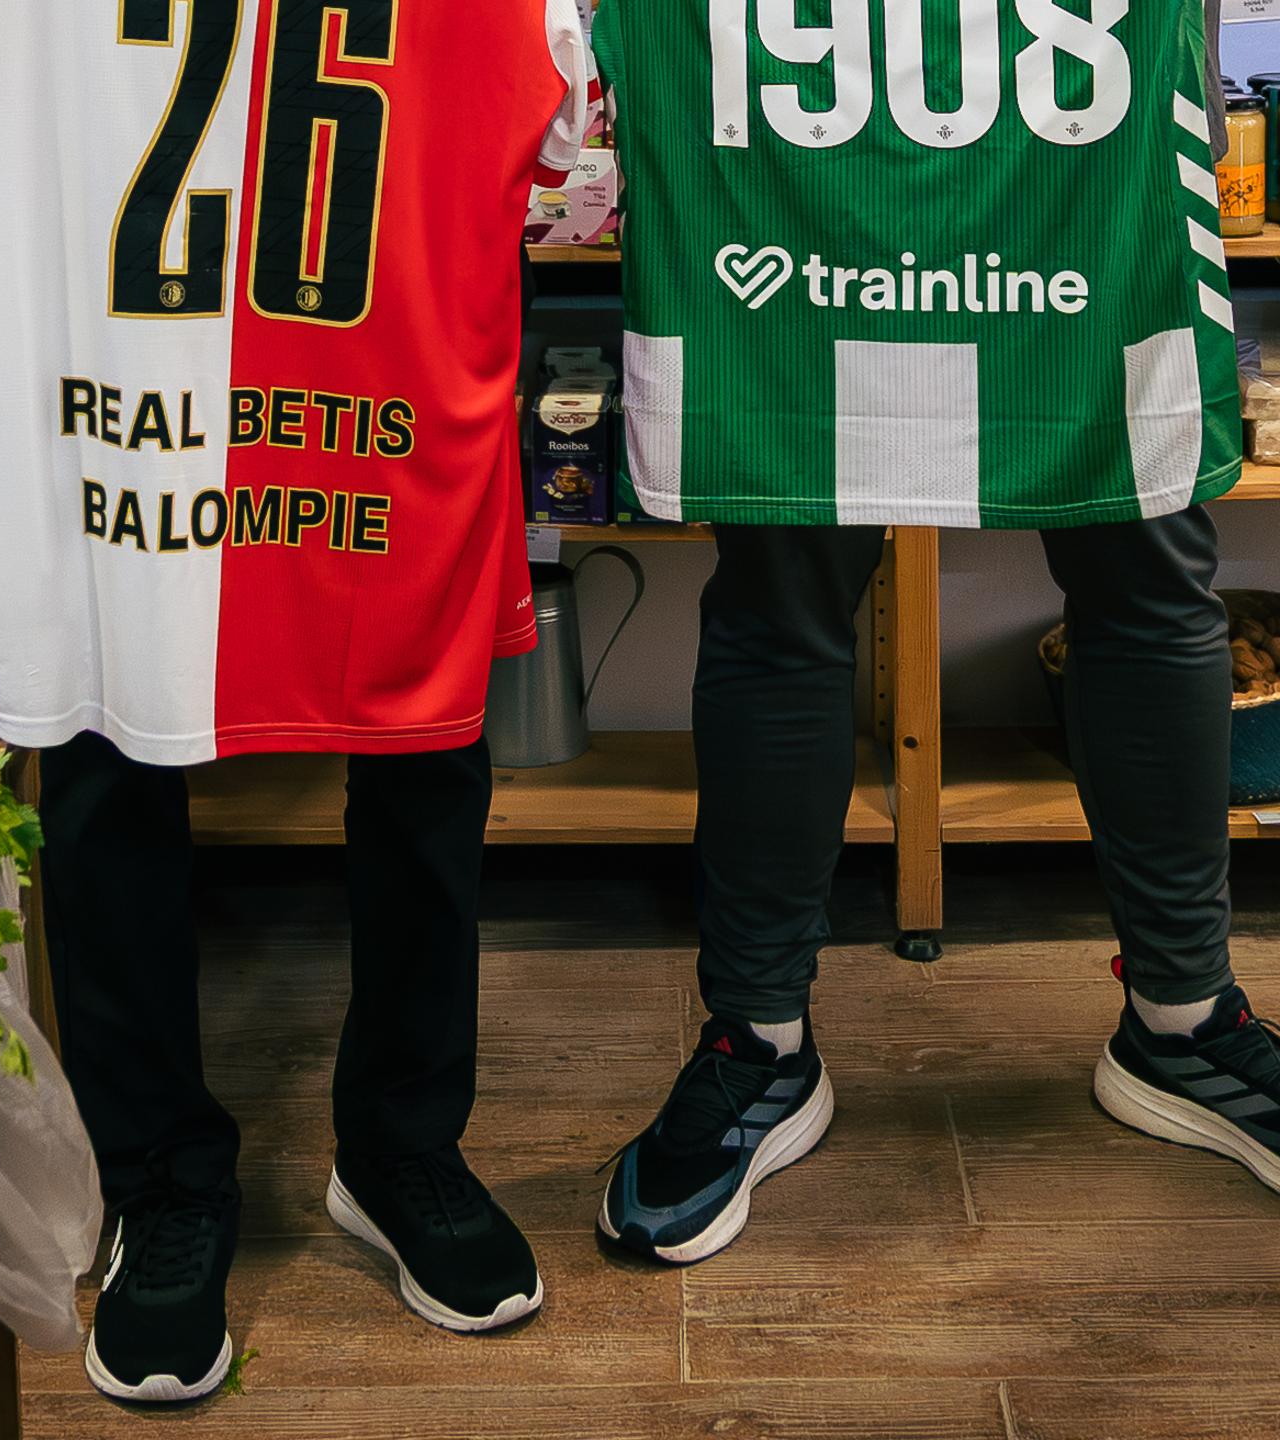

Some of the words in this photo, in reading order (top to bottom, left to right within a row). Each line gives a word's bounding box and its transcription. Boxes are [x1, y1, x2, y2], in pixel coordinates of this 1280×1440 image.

[802, 252, 1088, 314] trainline
[59, 375, 206, 453] REAL
[227, 386, 416, 459] BETIS
[548, 440, 590, 453] Rooibos
[82, 474, 391, 555] BALOMPIE
